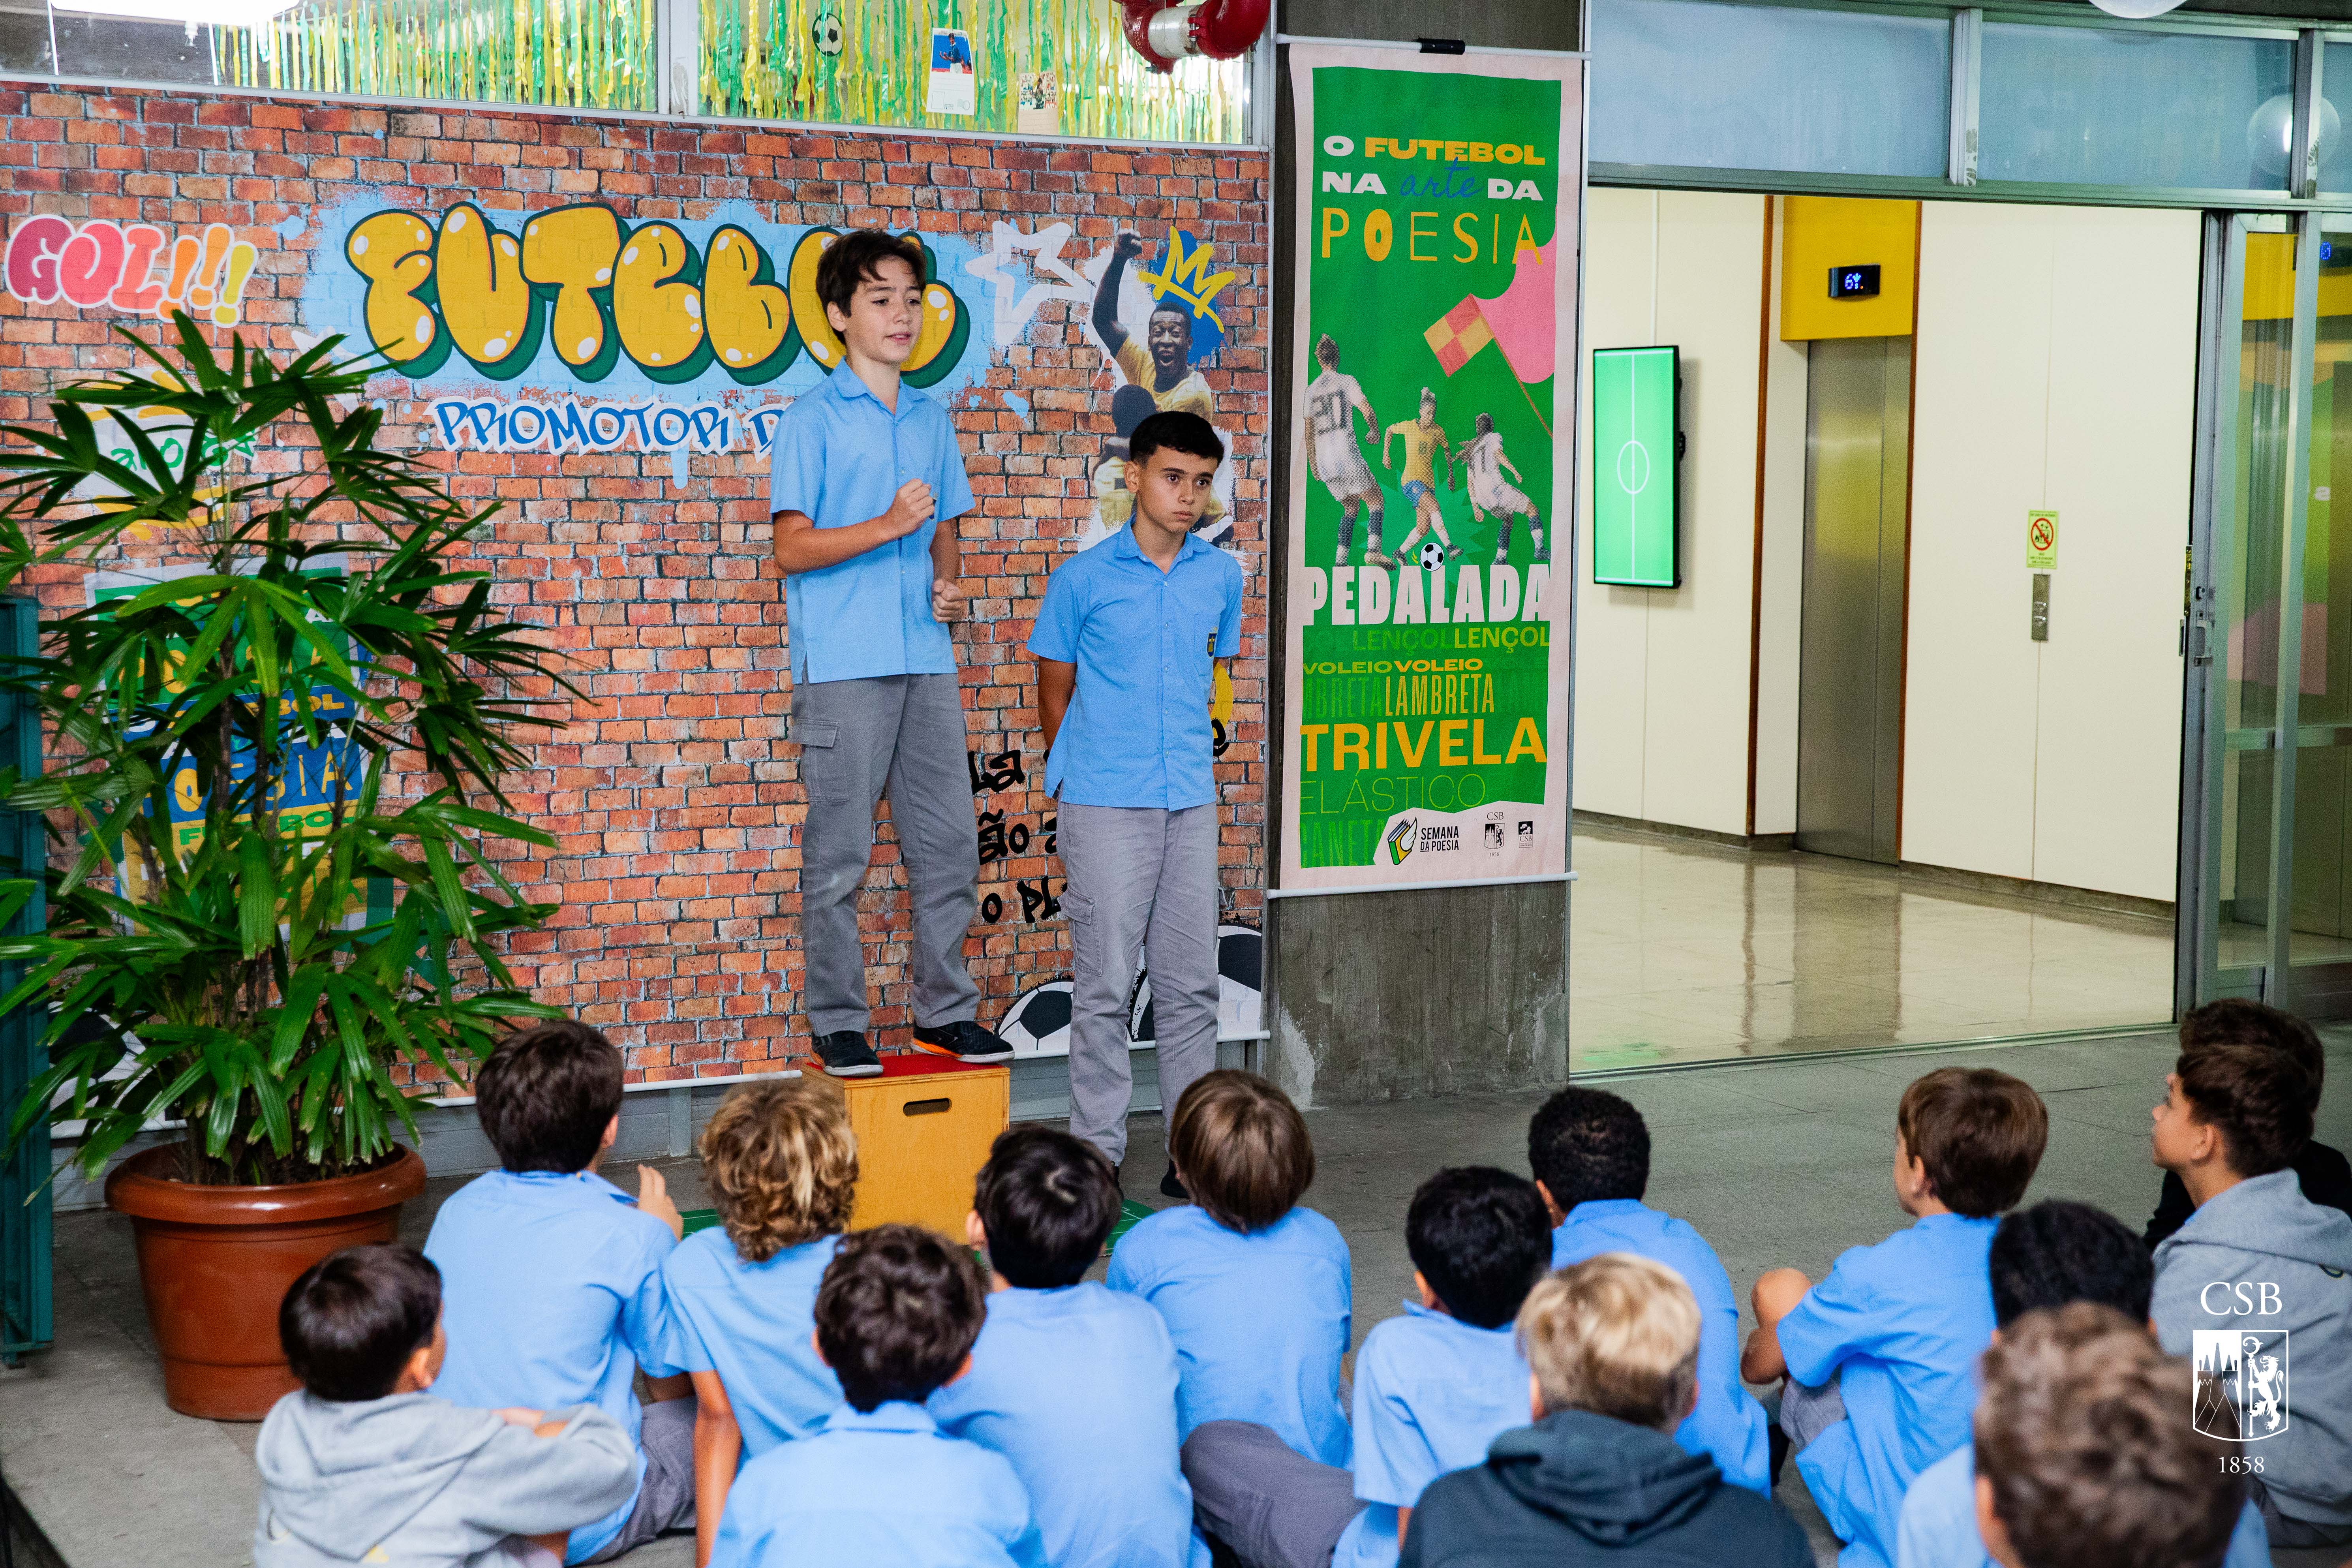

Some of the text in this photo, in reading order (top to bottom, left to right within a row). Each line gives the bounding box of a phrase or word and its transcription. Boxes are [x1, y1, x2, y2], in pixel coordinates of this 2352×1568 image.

[1323, 135, 1545, 165] O FUTEBOL
[1322, 156, 1543, 201] NA arte DA
[1321, 207, 1543, 266] POESIA
[434, 400, 729, 451] PROMOTOR
[1303, 563, 1550, 626] PEDALADA
[1394, 658, 1483, 673] VOLEIO
[1385, 673, 1495, 716] LAMBRETA
[1300, 717, 1548, 772] TRIVELA
[1421, 826, 1459, 840] SEMANA
[1487, 812, 1504, 821] CSB
[1420, 839, 1459, 852] DA POESIA
